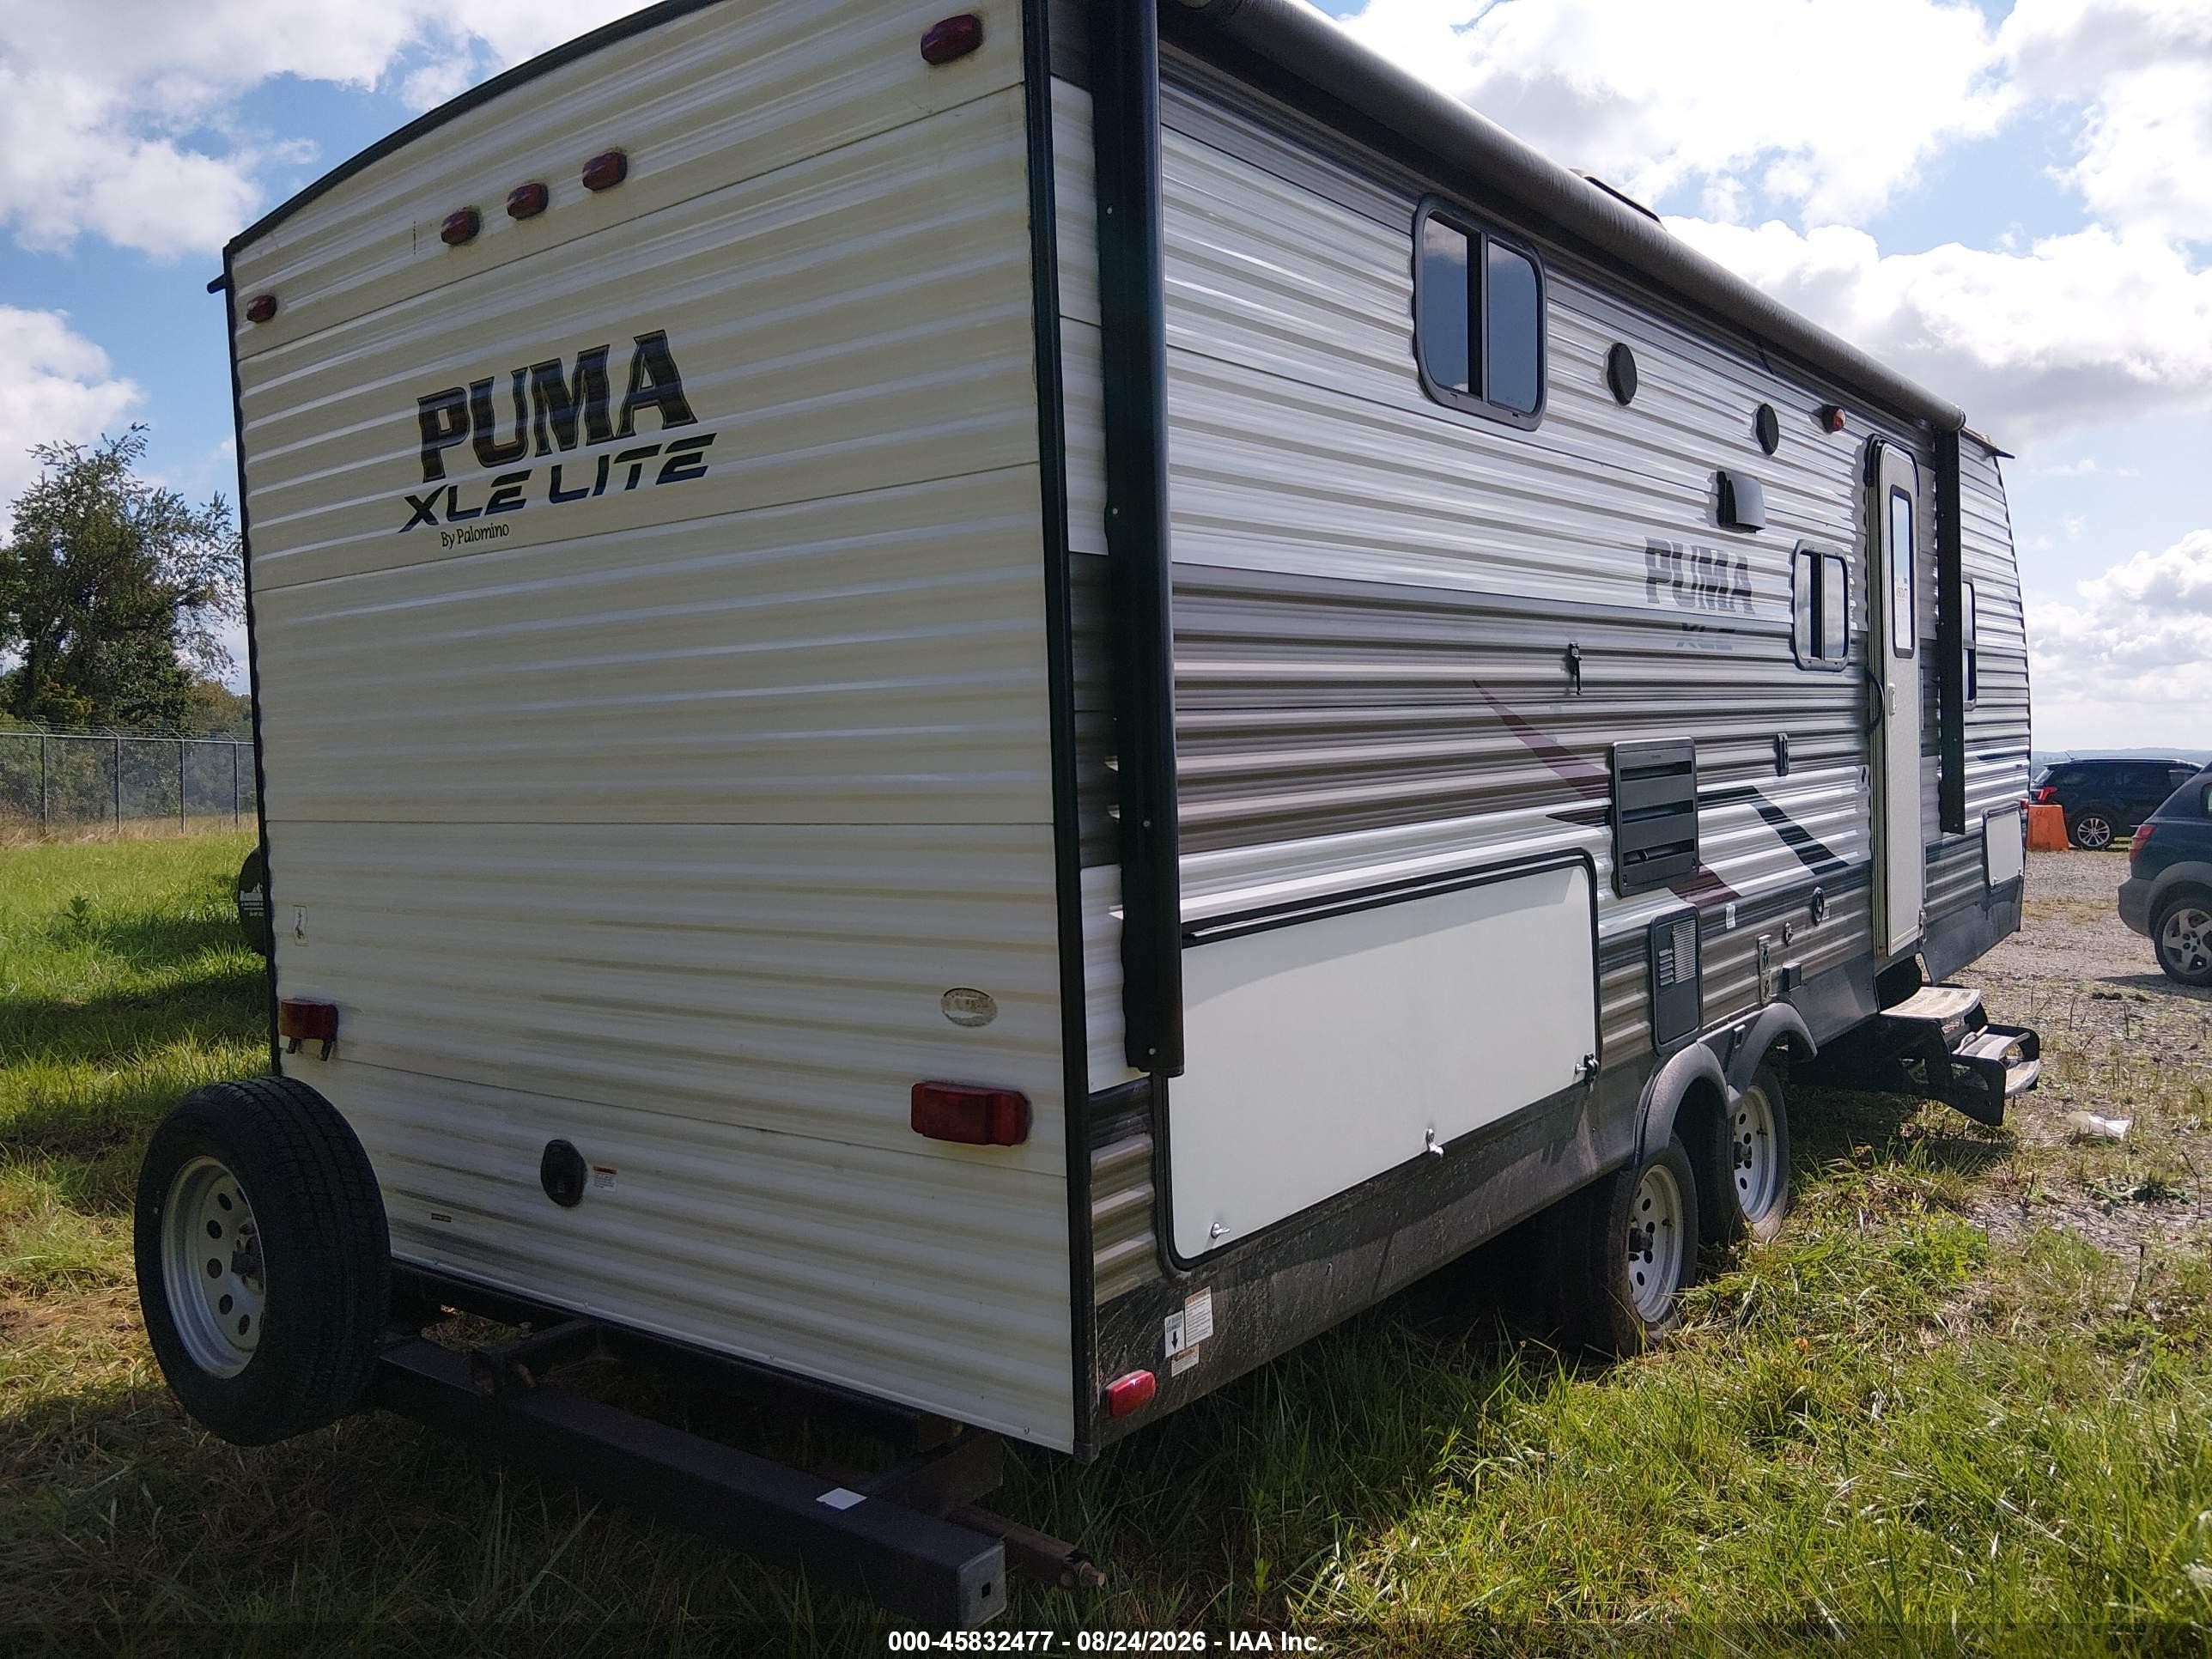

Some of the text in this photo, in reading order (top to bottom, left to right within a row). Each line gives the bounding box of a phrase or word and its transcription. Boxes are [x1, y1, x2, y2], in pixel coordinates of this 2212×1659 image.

[416, 329, 699, 483] PUMA
[398, 432, 718, 534] XLE LITE
[441, 522, 509, 550] By Palomino
[1644, 536, 1756, 615] PUMA
